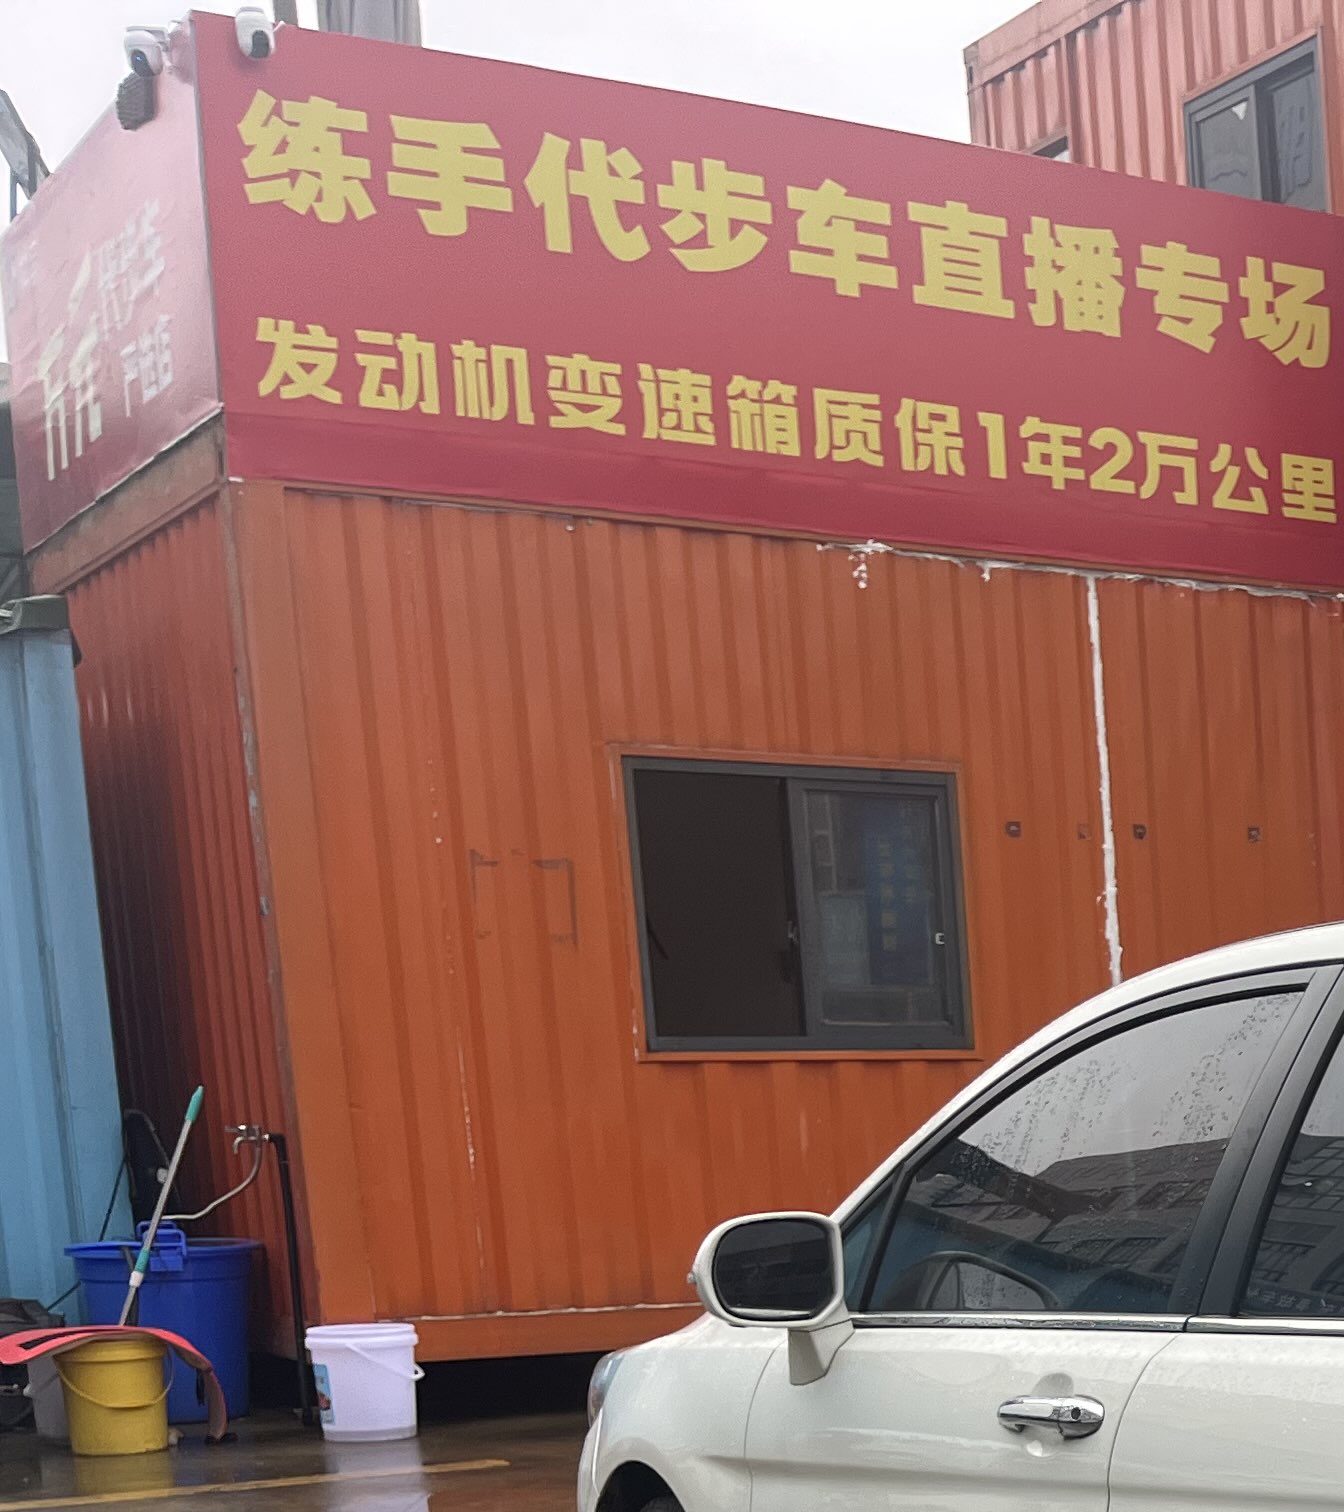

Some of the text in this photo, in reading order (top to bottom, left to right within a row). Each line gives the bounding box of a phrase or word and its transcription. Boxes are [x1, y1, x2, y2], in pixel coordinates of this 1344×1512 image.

[237, 89, 1332, 370] 练手代步车直播专场
[256, 317, 1338, 524] 发动机变速箱质保1年2万公里
